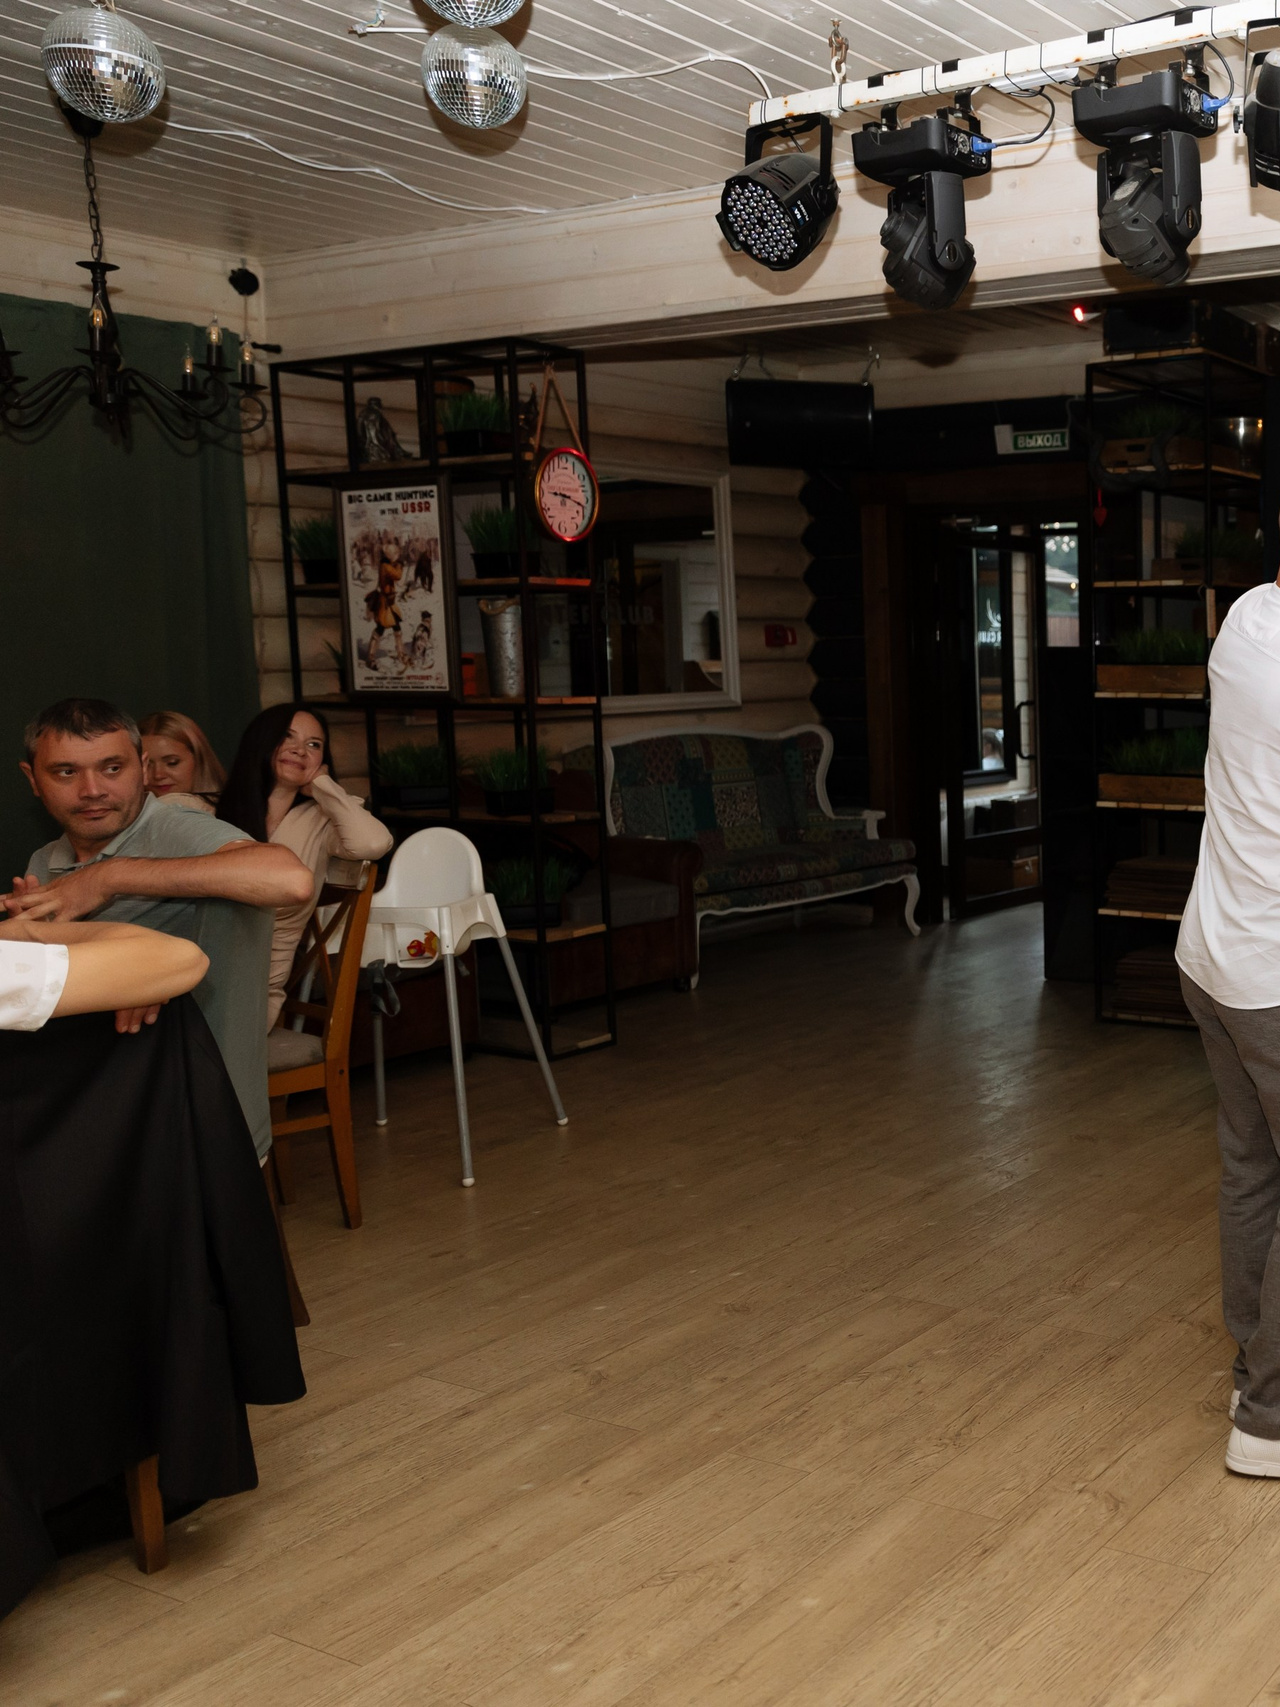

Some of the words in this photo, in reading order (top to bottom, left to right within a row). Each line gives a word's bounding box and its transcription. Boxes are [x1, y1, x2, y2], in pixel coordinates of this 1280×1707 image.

[1017, 433, 1062, 448] ВЫХОД
[366, 492, 392, 502] GAME
[395, 489, 434, 500] HUNTING
[401, 501, 431, 513] USSR
